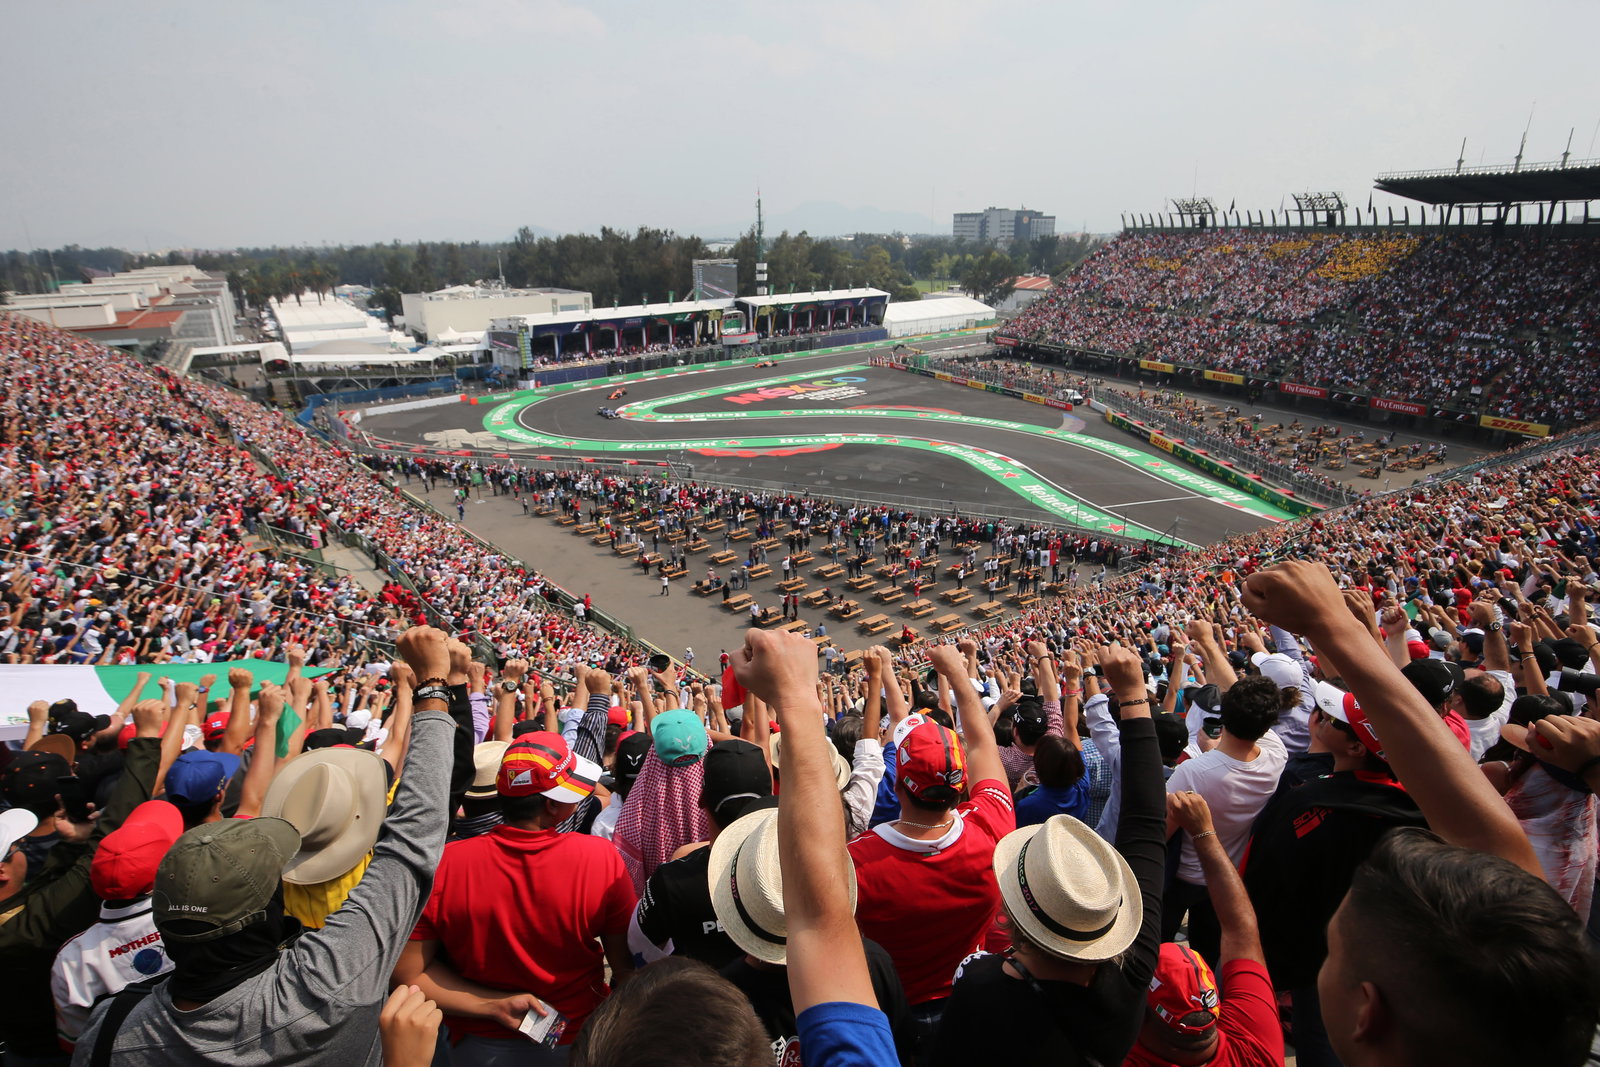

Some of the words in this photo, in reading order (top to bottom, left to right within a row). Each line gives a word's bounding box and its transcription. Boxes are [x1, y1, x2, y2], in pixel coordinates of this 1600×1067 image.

[1284, 384, 1295, 393] Fly
[1295, 385, 1321, 396] Emirates
[1376, 400, 1388, 409] Fly
[1388, 402, 1419, 413] Emirates
[1490, 418, 1532, 432] DHL
[618, 441, 718, 449] Heineken
[1153, 436, 1170, 450] DHL
[936, 444, 1003, 472] Heineken
[1163, 468, 1252, 501] Heineken
[1020, 484, 1099, 522] Heineken
[1023, 886, 1039, 911] 2017
[191, 905, 208, 913] ONE
